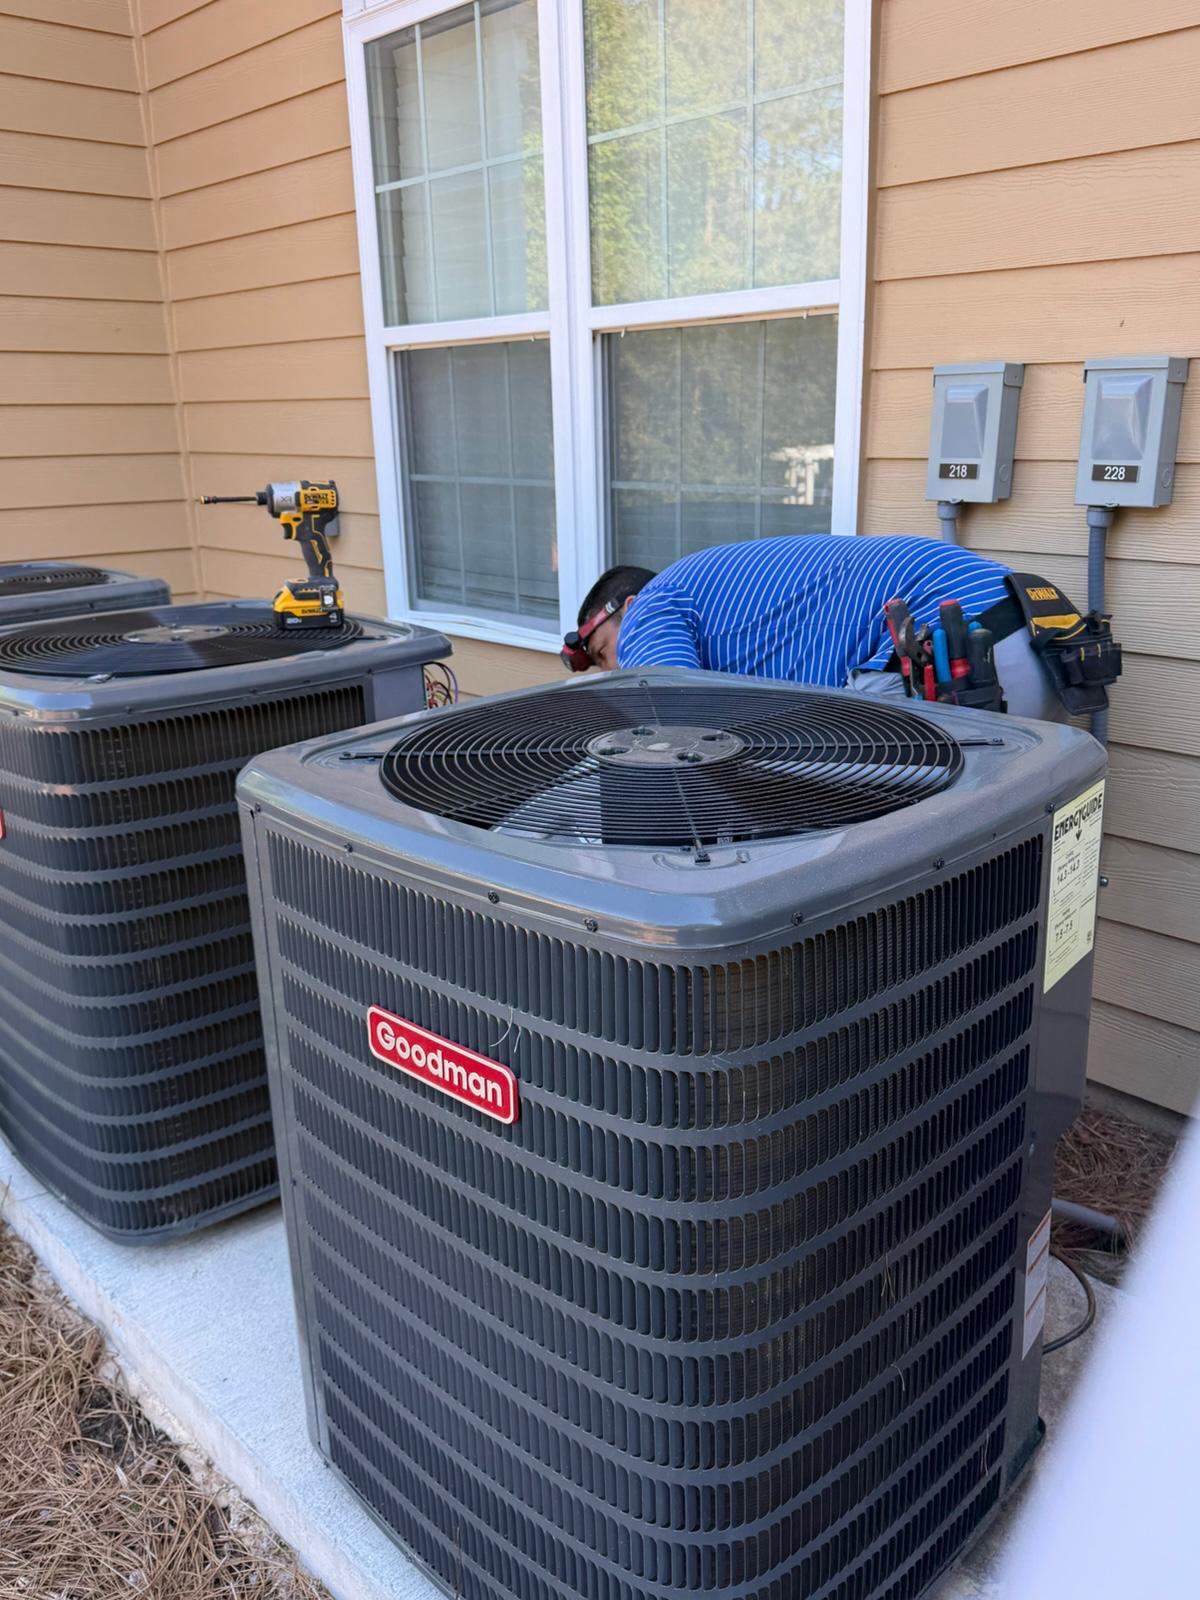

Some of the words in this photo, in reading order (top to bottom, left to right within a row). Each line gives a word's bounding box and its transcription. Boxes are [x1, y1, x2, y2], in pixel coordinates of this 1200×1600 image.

[949, 464, 968, 478] 218
[1103, 465, 1126, 481] 228
[376, 1021, 503, 1108] Goodman
